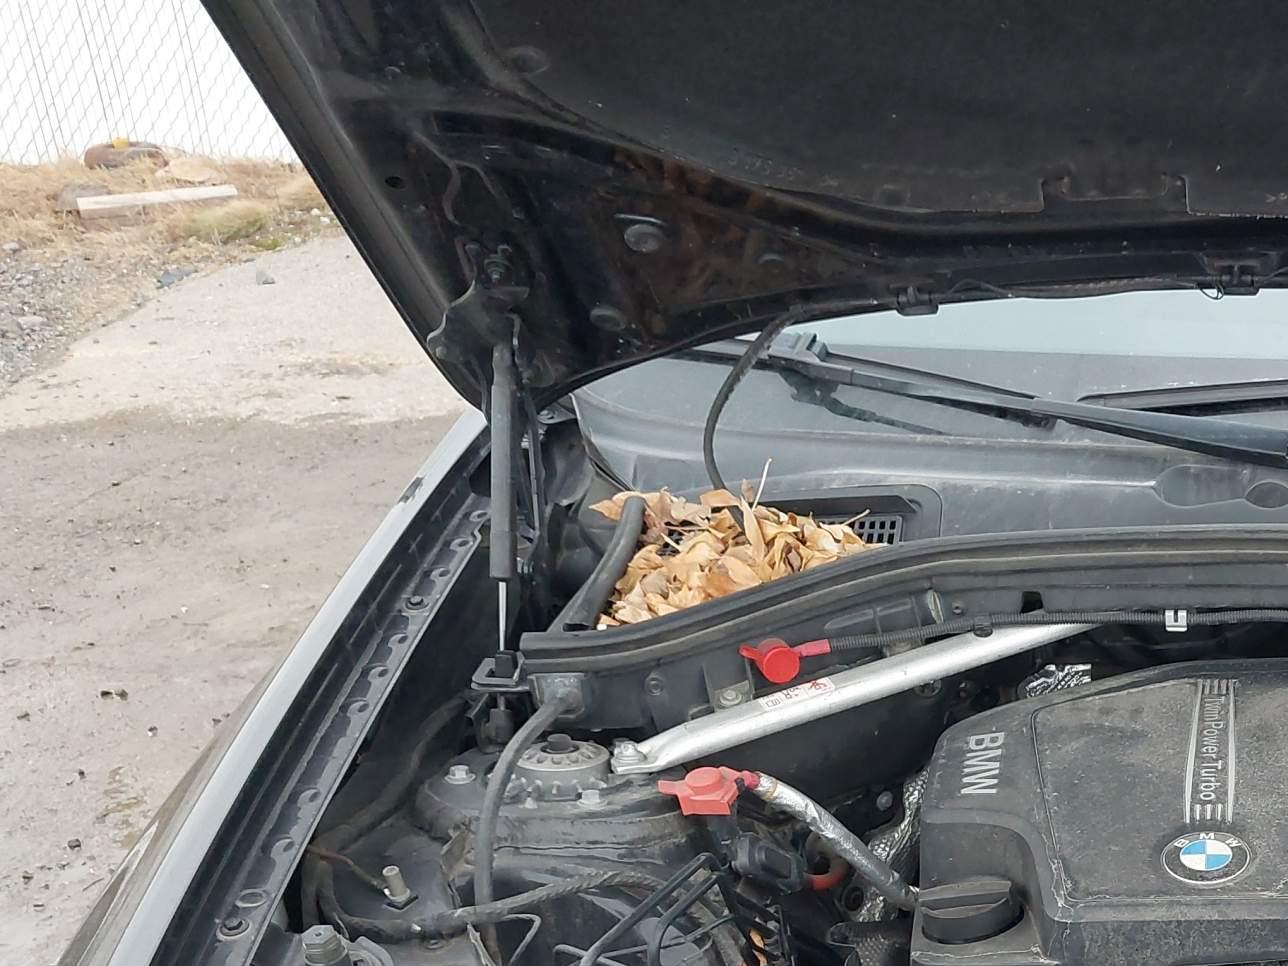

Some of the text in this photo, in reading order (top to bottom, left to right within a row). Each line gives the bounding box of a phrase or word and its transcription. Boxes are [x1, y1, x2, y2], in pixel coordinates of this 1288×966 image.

[960, 732, 1005, 794] BMW
[1199, 696, 1226, 801] TwinPower Turbo
[1173, 832, 1242, 849] BMW
